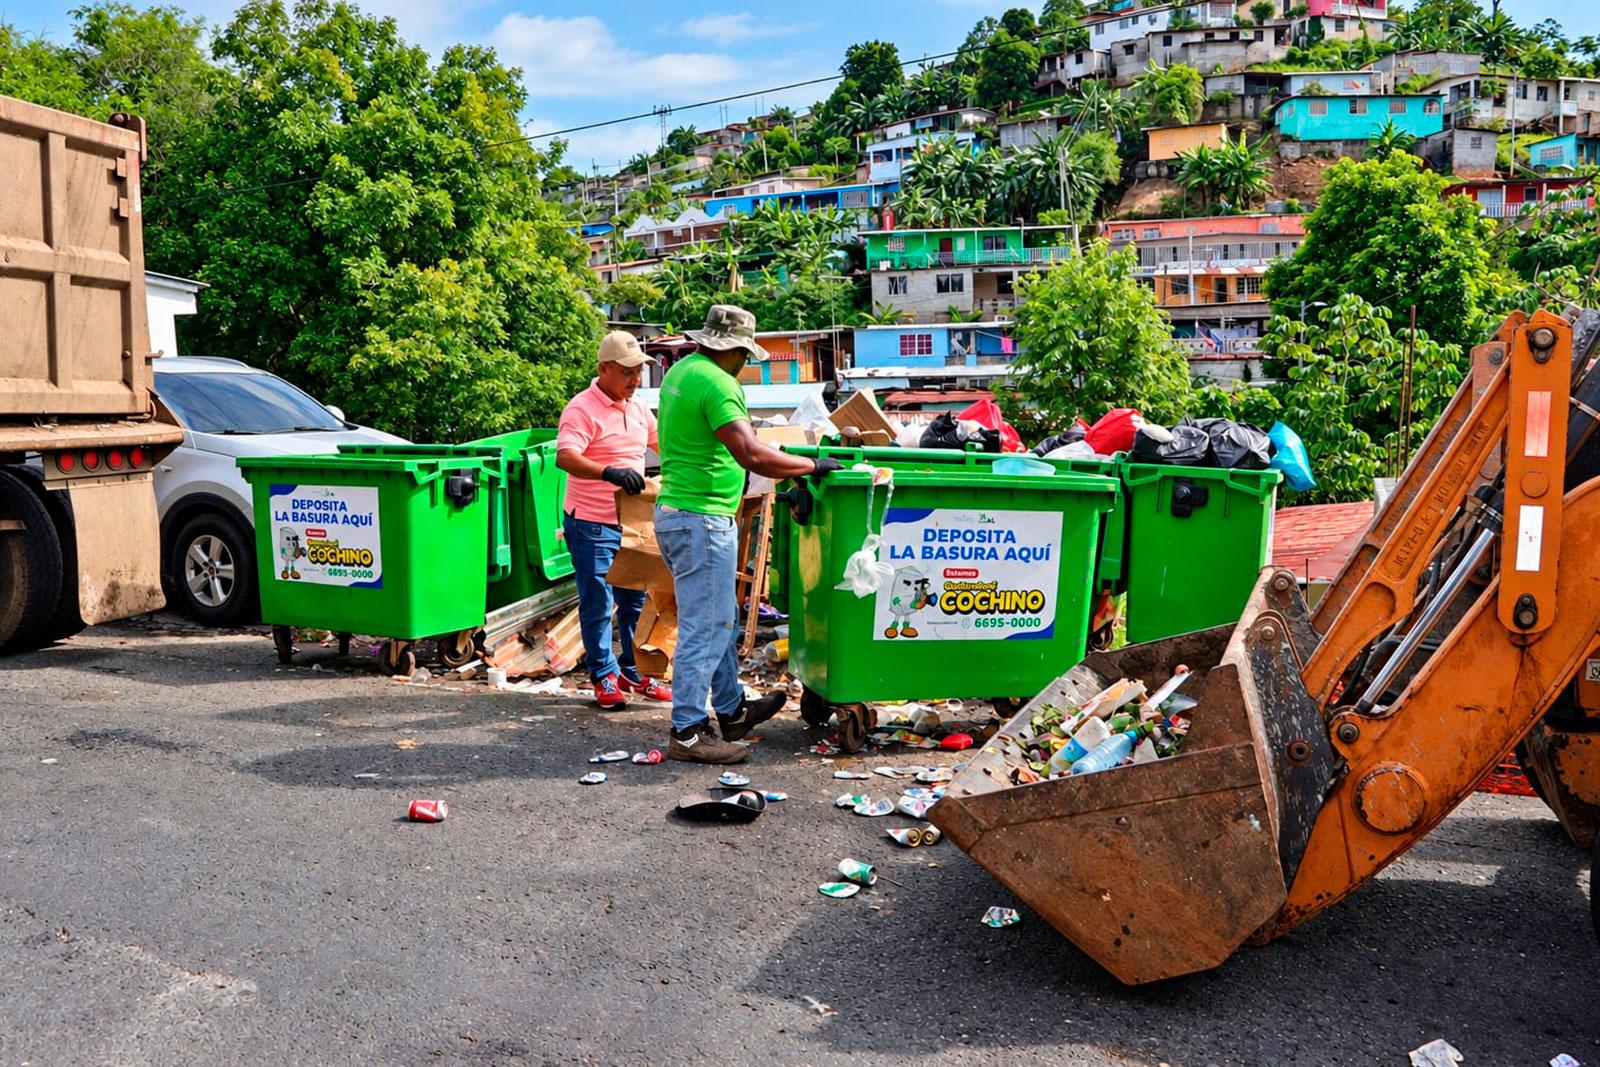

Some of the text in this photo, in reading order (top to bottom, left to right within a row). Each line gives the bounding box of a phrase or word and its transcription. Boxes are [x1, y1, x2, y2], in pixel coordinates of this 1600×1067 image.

[291, 498, 348, 512] DEPOSITA
[274, 511, 373, 527] LA BASURA AQUÍ
[922, 528, 1017, 544] DEPOSITA
[307, 545, 374, 567] COCHINO
[889, 543, 1052, 564] LA BASURA AQUÍ
[940, 589, 1045, 614] COCHINO
[974, 616, 1042, 629] 6695-0000
